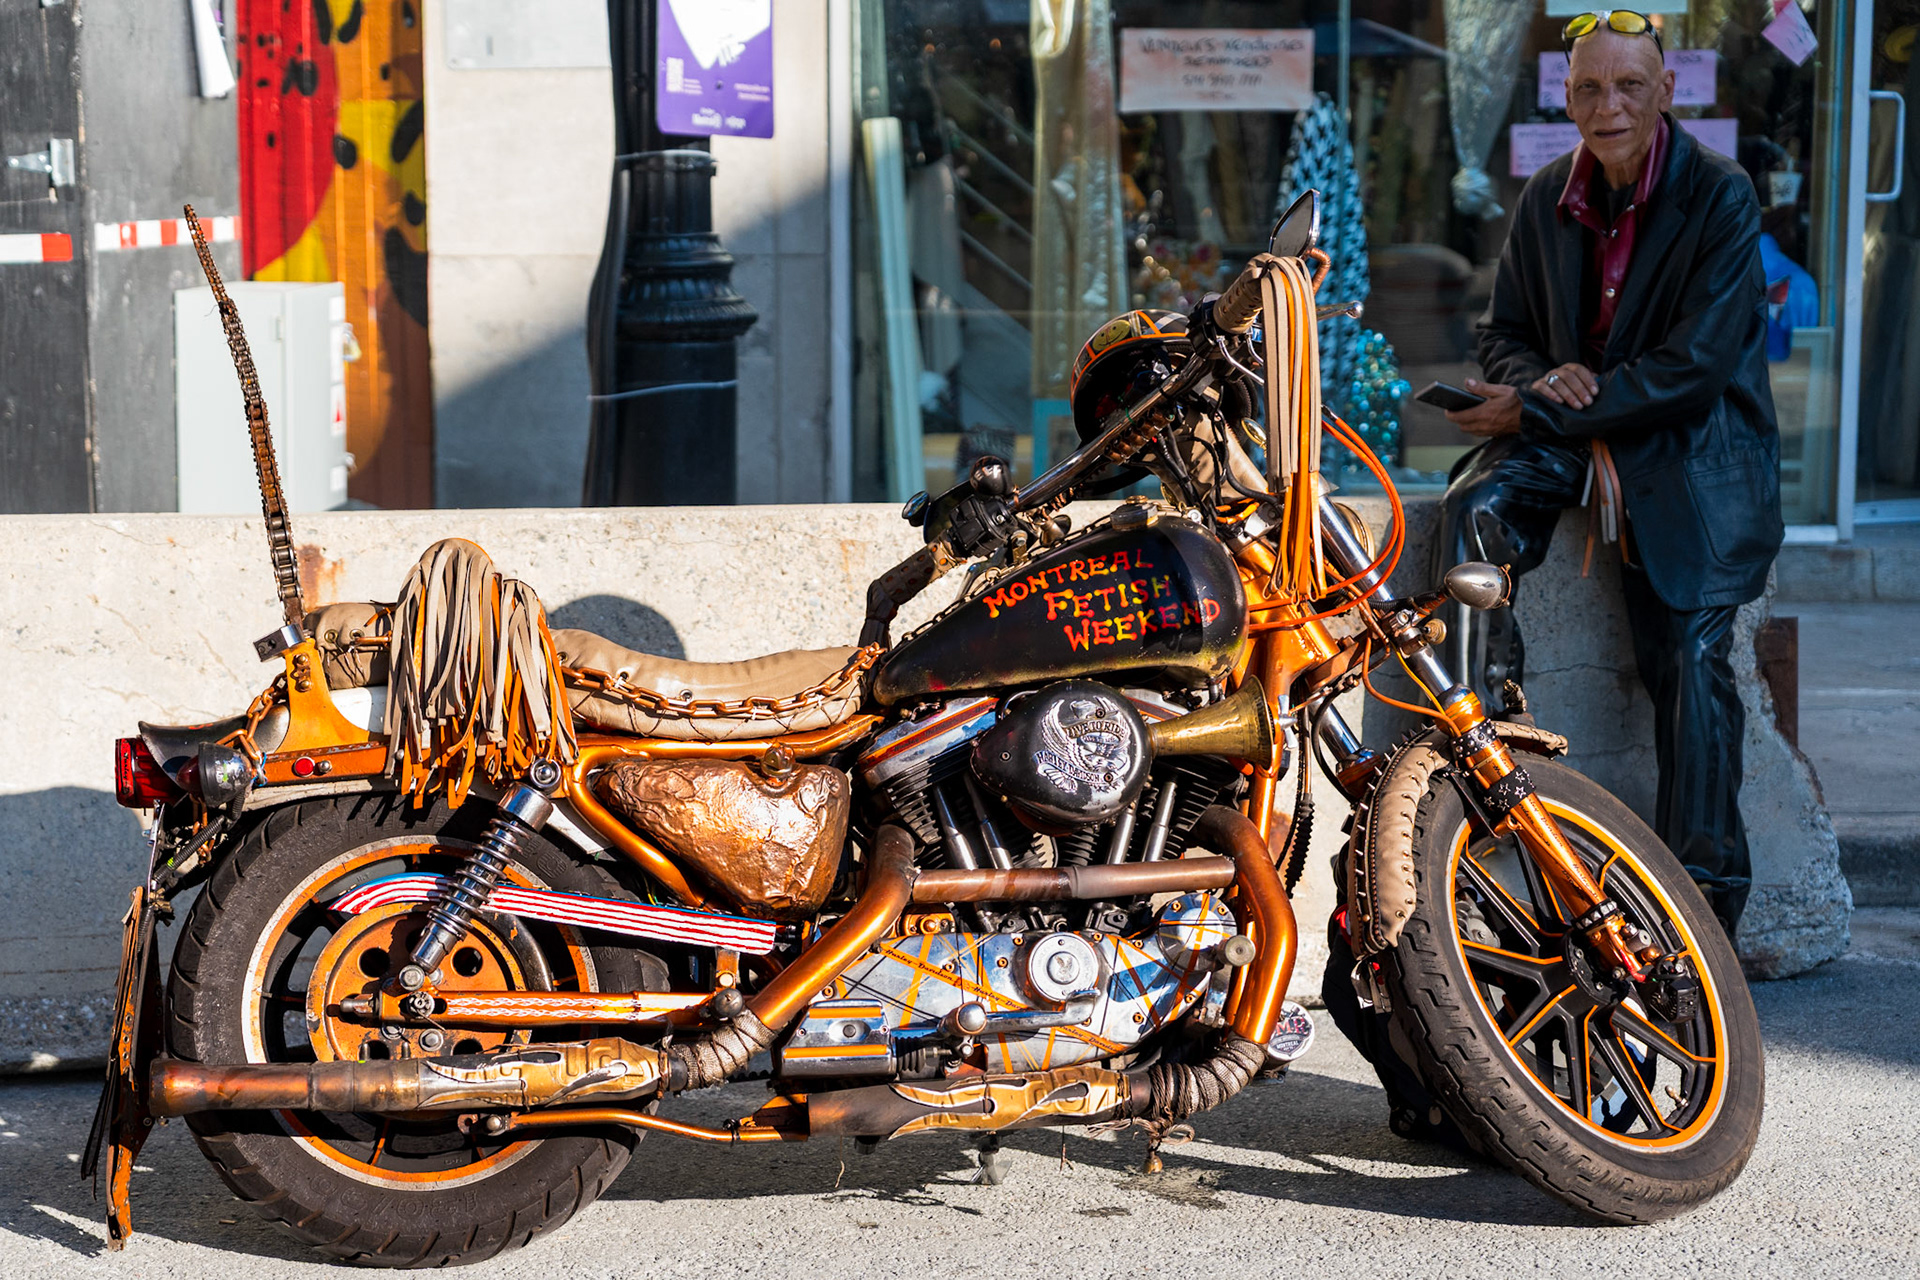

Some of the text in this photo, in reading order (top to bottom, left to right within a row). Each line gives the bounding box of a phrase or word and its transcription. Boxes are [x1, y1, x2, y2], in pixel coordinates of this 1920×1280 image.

[983, 549, 1154, 618] MONTREAL
[1043, 574, 1170, 620] FETISH
[1064, 598, 1221, 652] WEEKEND
[1067, 723, 1089, 738] LIVE
[1090, 720, 1102, 732] TO
[1103, 721, 1126, 740] RIDE
